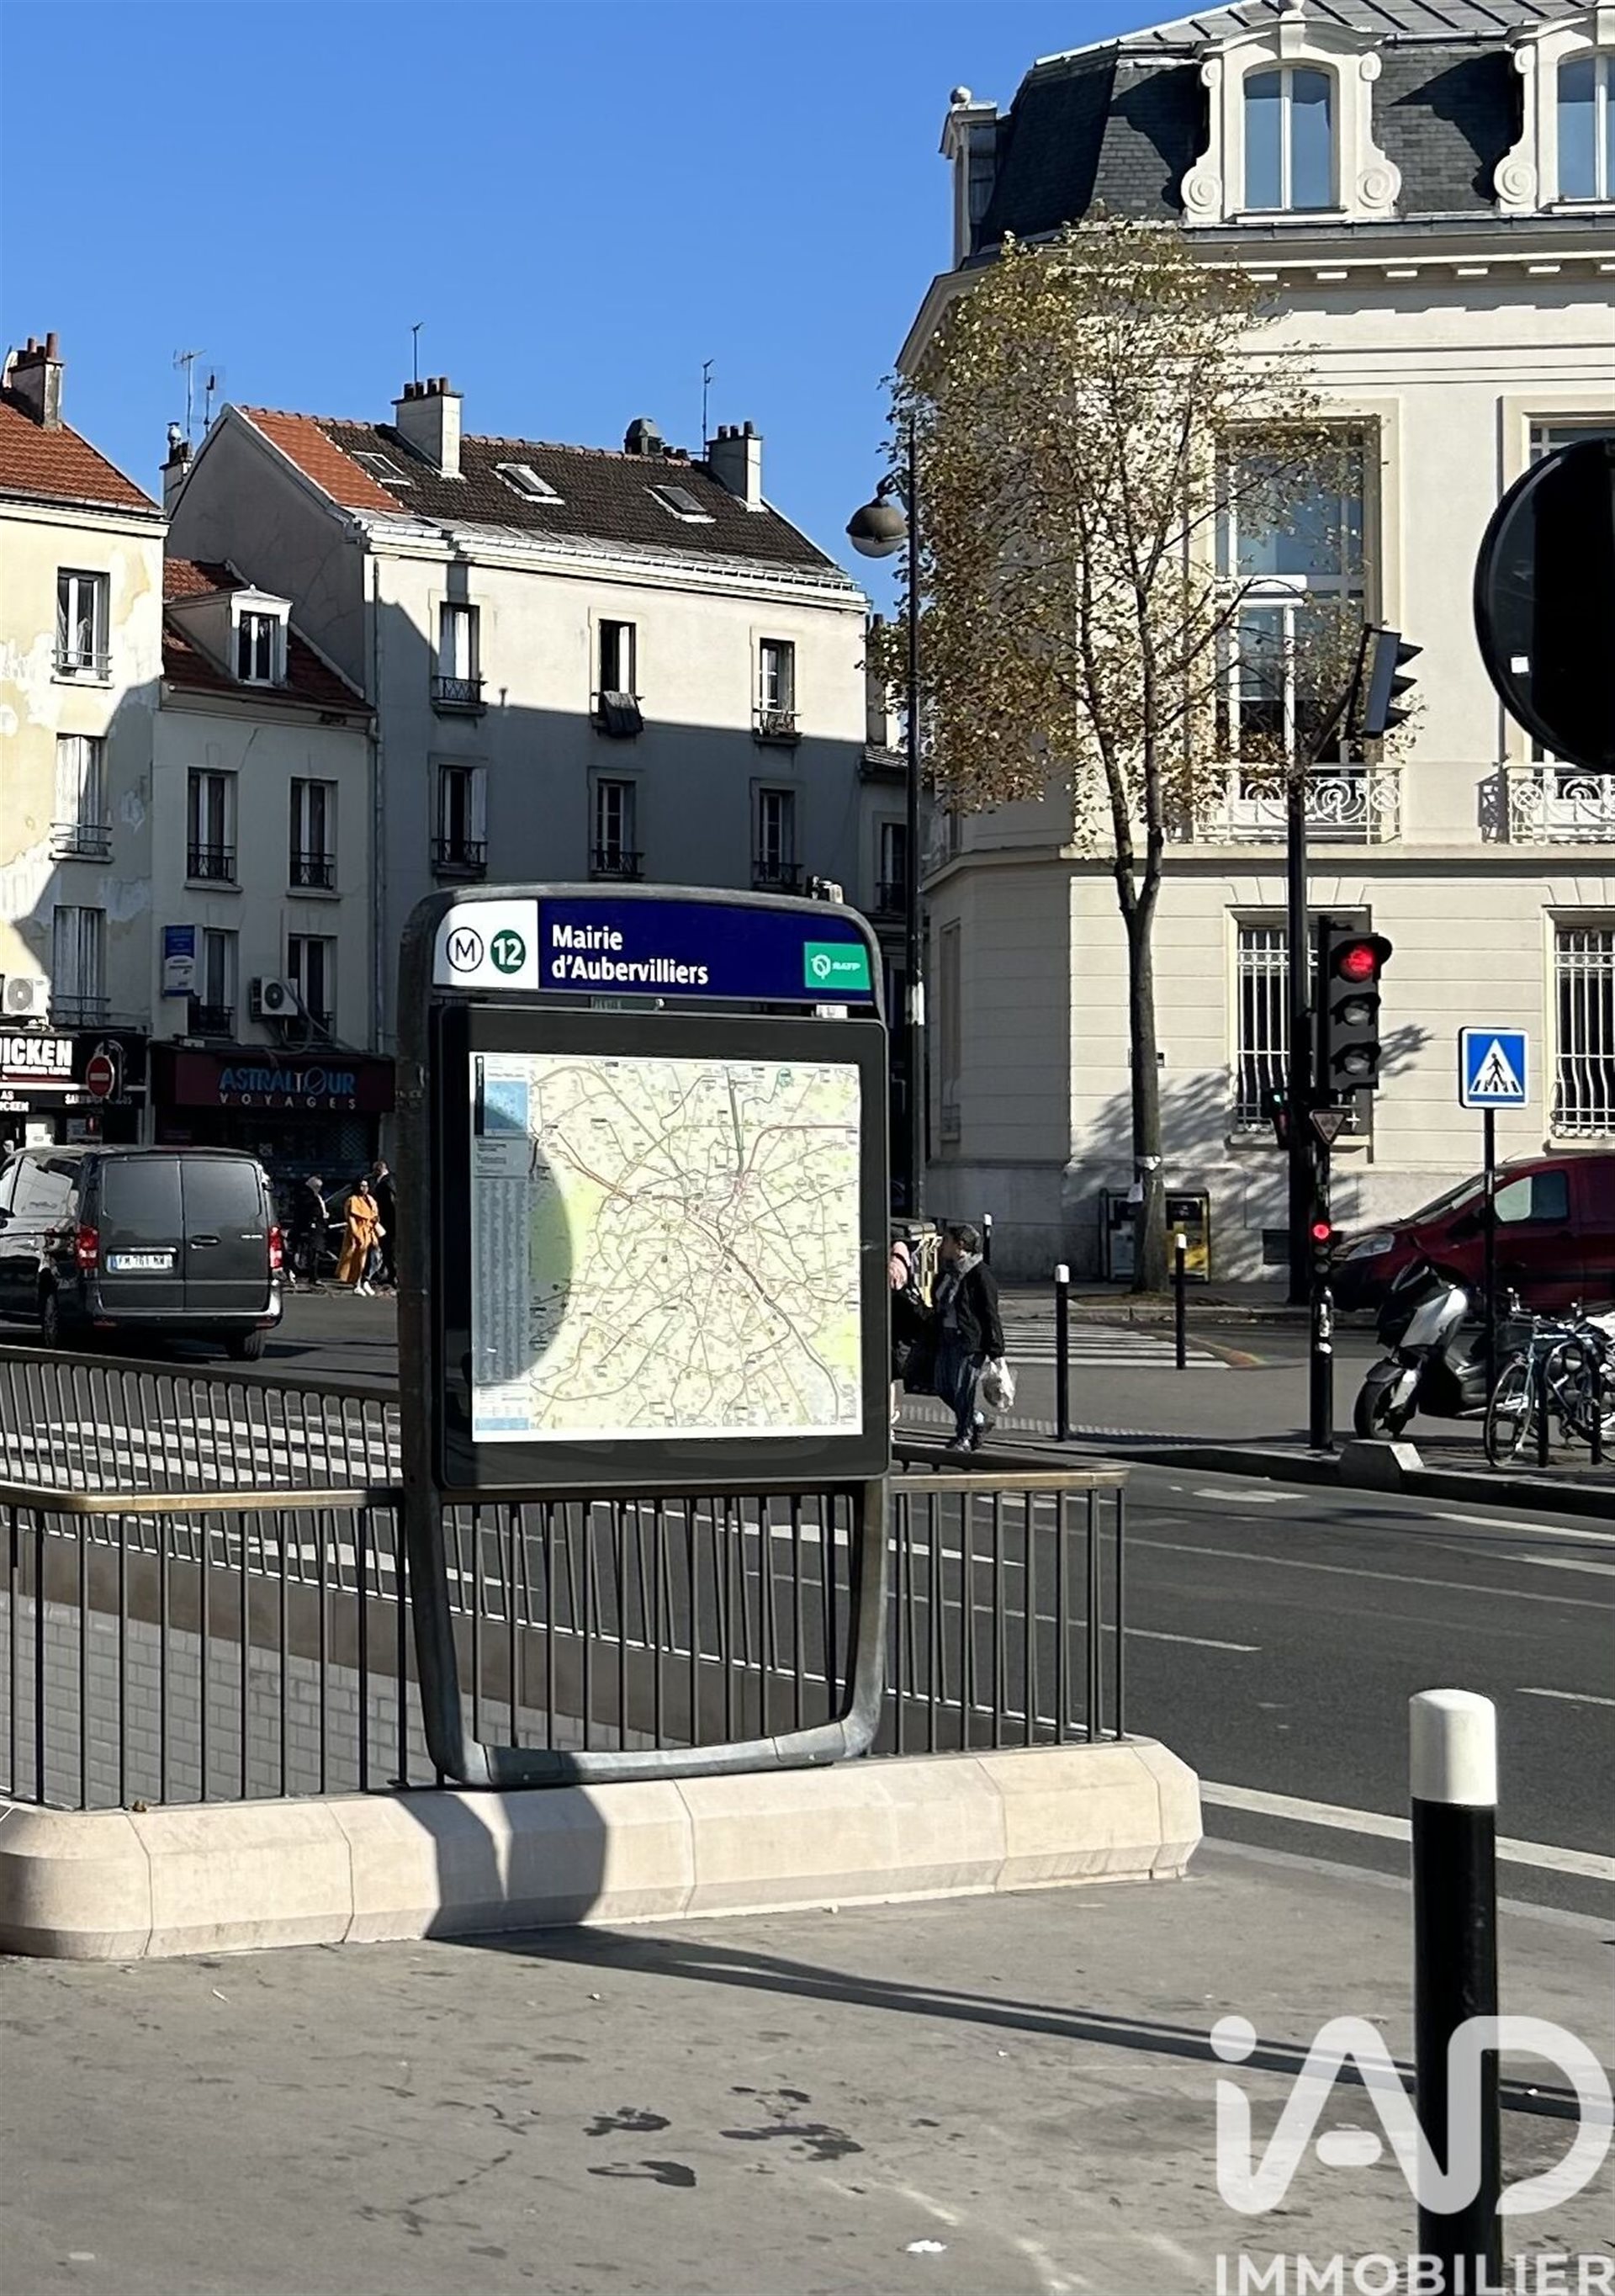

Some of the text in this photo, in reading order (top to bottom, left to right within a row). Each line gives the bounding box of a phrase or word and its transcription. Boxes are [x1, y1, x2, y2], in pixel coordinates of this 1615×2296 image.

[493, 937, 522, 967] 12
[552, 924, 623, 951] Mairie
[551, 954, 709, 985] d'Aubervilliers
[0, 1037, 72, 1067] ICKEN
[220, 1092, 356, 1110] VOYAGES
